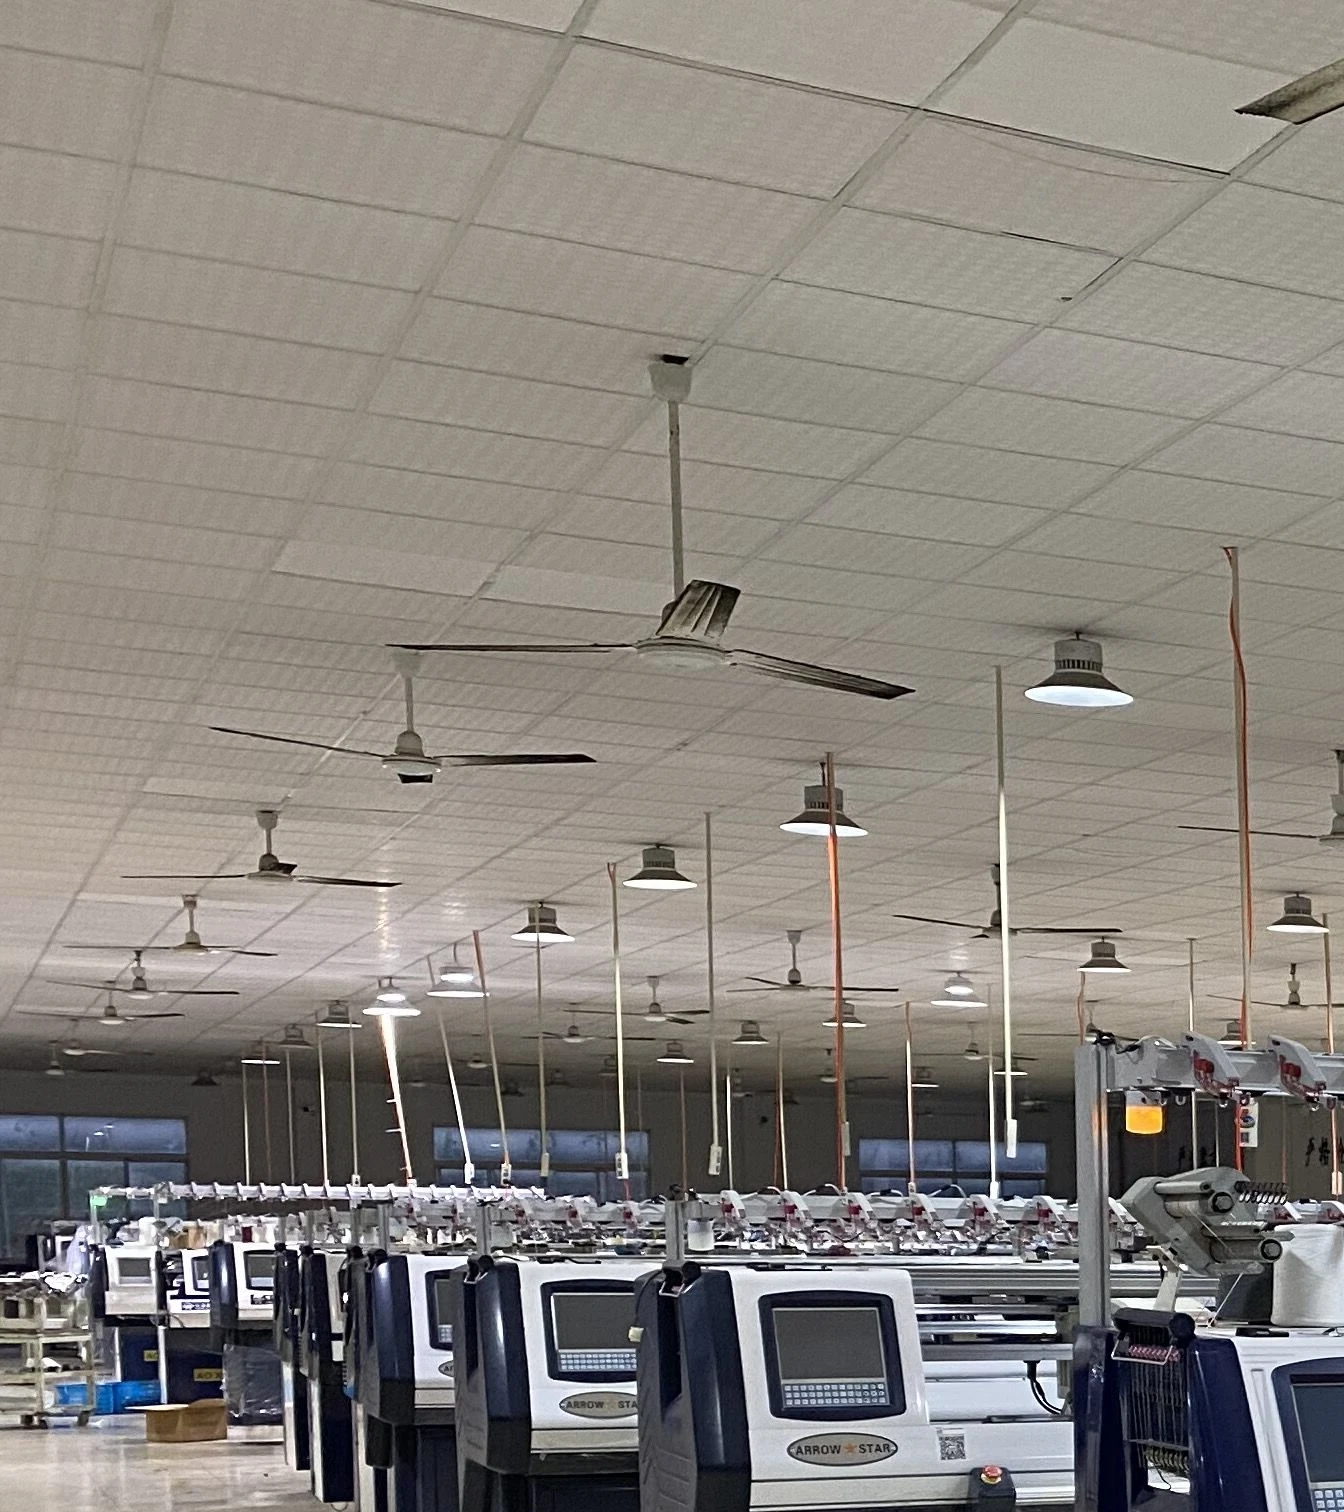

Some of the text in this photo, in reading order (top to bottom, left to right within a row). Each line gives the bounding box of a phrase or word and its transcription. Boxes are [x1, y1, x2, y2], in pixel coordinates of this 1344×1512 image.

[566, 1400, 604, 1409] ARROW
[795, 1443, 891, 1456] ARROW STAR
